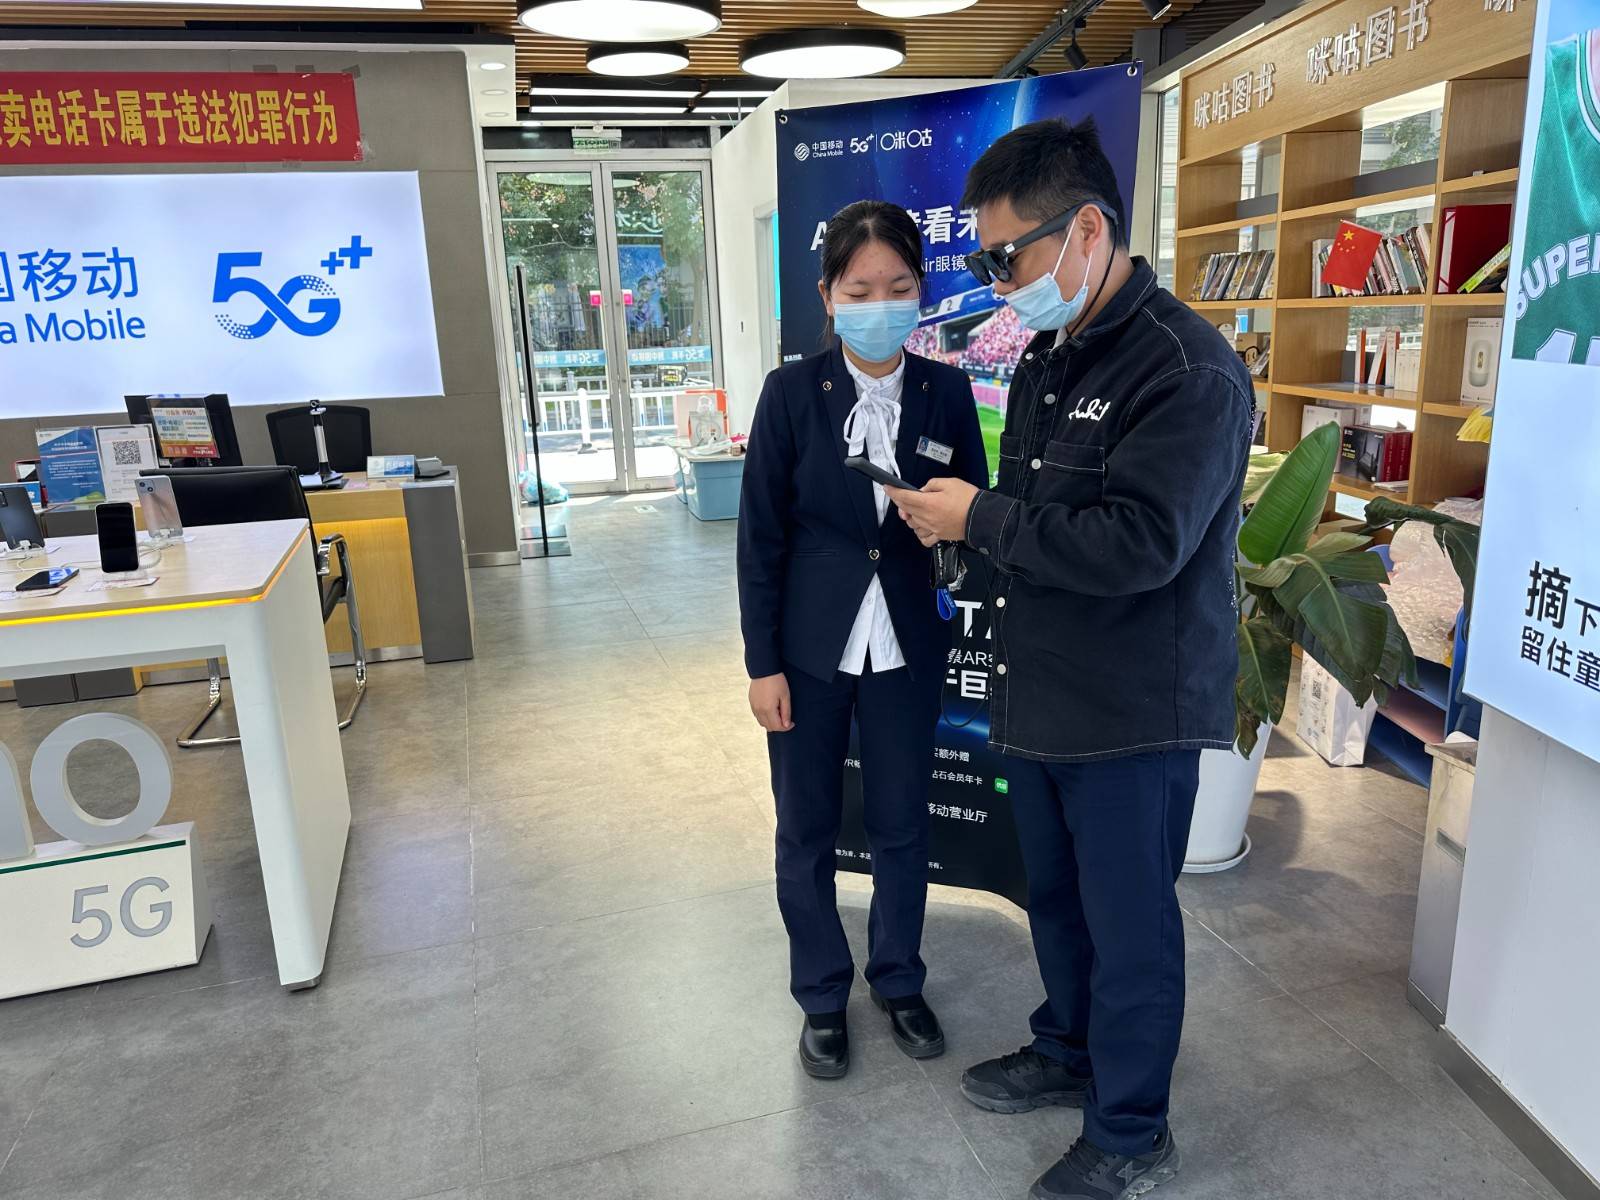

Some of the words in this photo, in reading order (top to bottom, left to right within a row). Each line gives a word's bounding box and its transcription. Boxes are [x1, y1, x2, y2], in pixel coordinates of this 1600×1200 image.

[1306, 0, 1431, 85] 咪咕图书
[0, 88, 338, 148] 卖电话卡属于违法犯罪行为
[1193, 62, 1275, 129] 咪咕图书
[812, 140, 844, 152] 中国移动
[812, 150, 827, 158] China
[827, 149, 844, 157] Mobile
[0, 246, 139, 303] 移动
[921, 254, 968, 273] ir眼镜
[25, 308, 146, 342] Mobile
[70, 876, 173, 948] 5G
